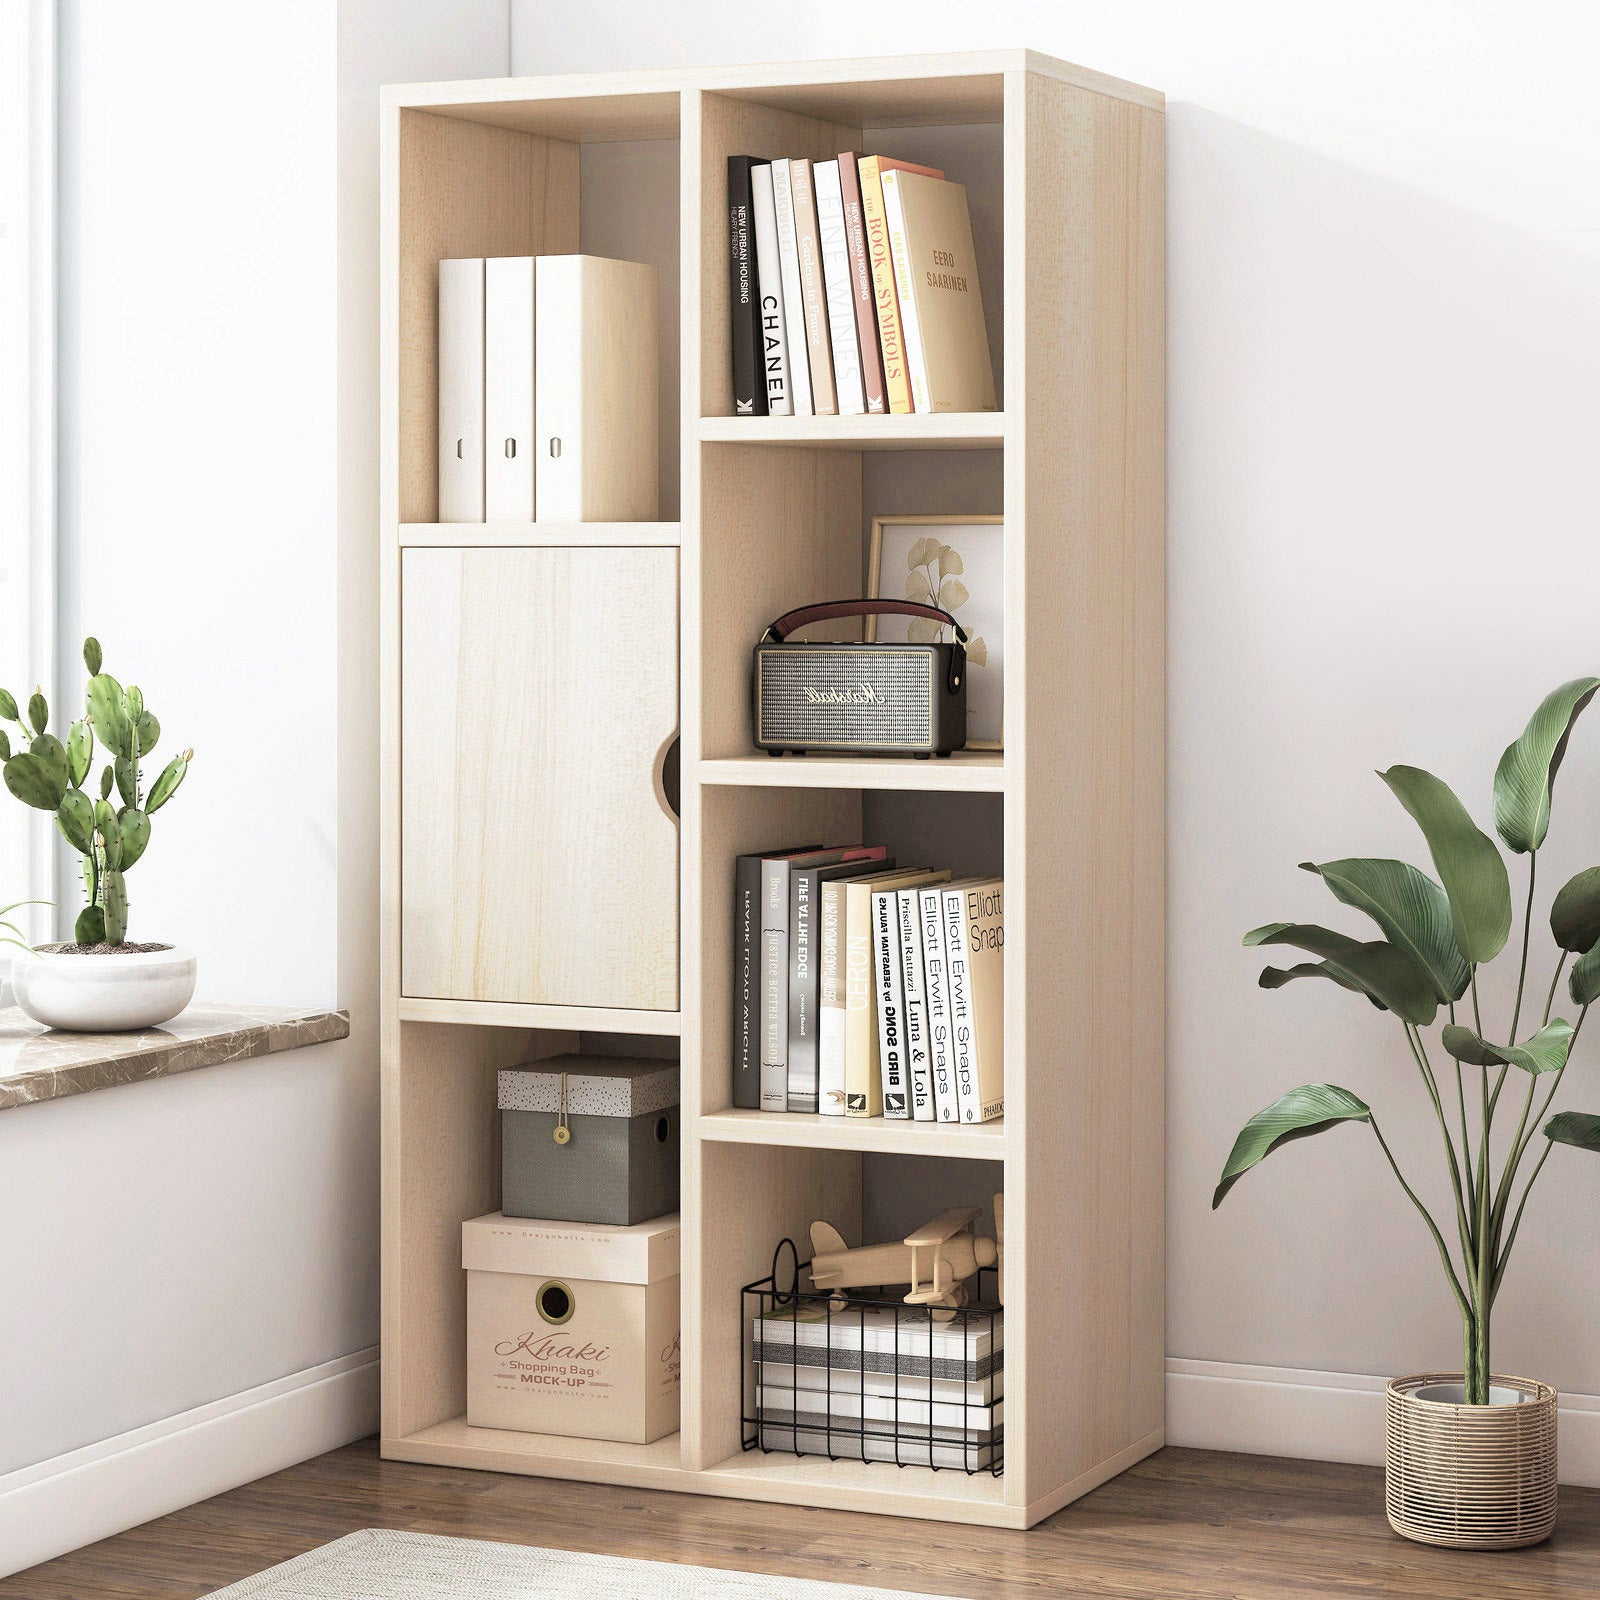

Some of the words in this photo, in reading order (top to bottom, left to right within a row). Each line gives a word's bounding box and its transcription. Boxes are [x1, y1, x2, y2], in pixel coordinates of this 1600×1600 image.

[738, 205, 747, 227] NEW
[818, 195, 846, 265] FINE
[850, 201, 859, 223] NEW
[731, 231, 739, 259] FRENCH
[738, 228, 748, 260] URBAN
[802, 236, 813, 287] Gardens
[853, 225, 863, 257] URBAN
[933, 250, 955, 268] EERO
[740, 262, 749, 304] HOUSING
[857, 259, 869, 301] HOUSING
[869, 218, 887, 267] BOOK
[878, 288, 900, 379] SYMBOLS
[926, 272, 968, 292] SAARINEN
[807, 304, 821, 345] France
[829, 275, 859, 381] WINES
[762, 295, 785, 410] CHANEL
[769, 877, 781, 909] Brooks
[968, 889, 1002, 921] Elliott
[902, 898, 911, 942] Priscilla
[925, 896, 938, 951] Elliott
[947, 897, 962, 953] Elliott
[847, 935, 869, 1012] CERON
[905, 946, 917, 992] Rattazzi
[929, 959, 943, 1018] Erwitt
[952, 960, 966, 1020] Erwitt
[909, 1000, 922, 1042] Luna
[912, 1048, 926, 1064] &
[934, 1025, 949, 1095] Snaps
[957, 1026, 972, 1097] Snaps
[914, 1068, 928, 1108] Lola
[494, 1331, 613, 1362] Khaki
[509, 1360, 567, 1376] Shopping
[570, 1364, 595, 1378] Bag
[520, 1373, 586, 1388] MOCK-UP
